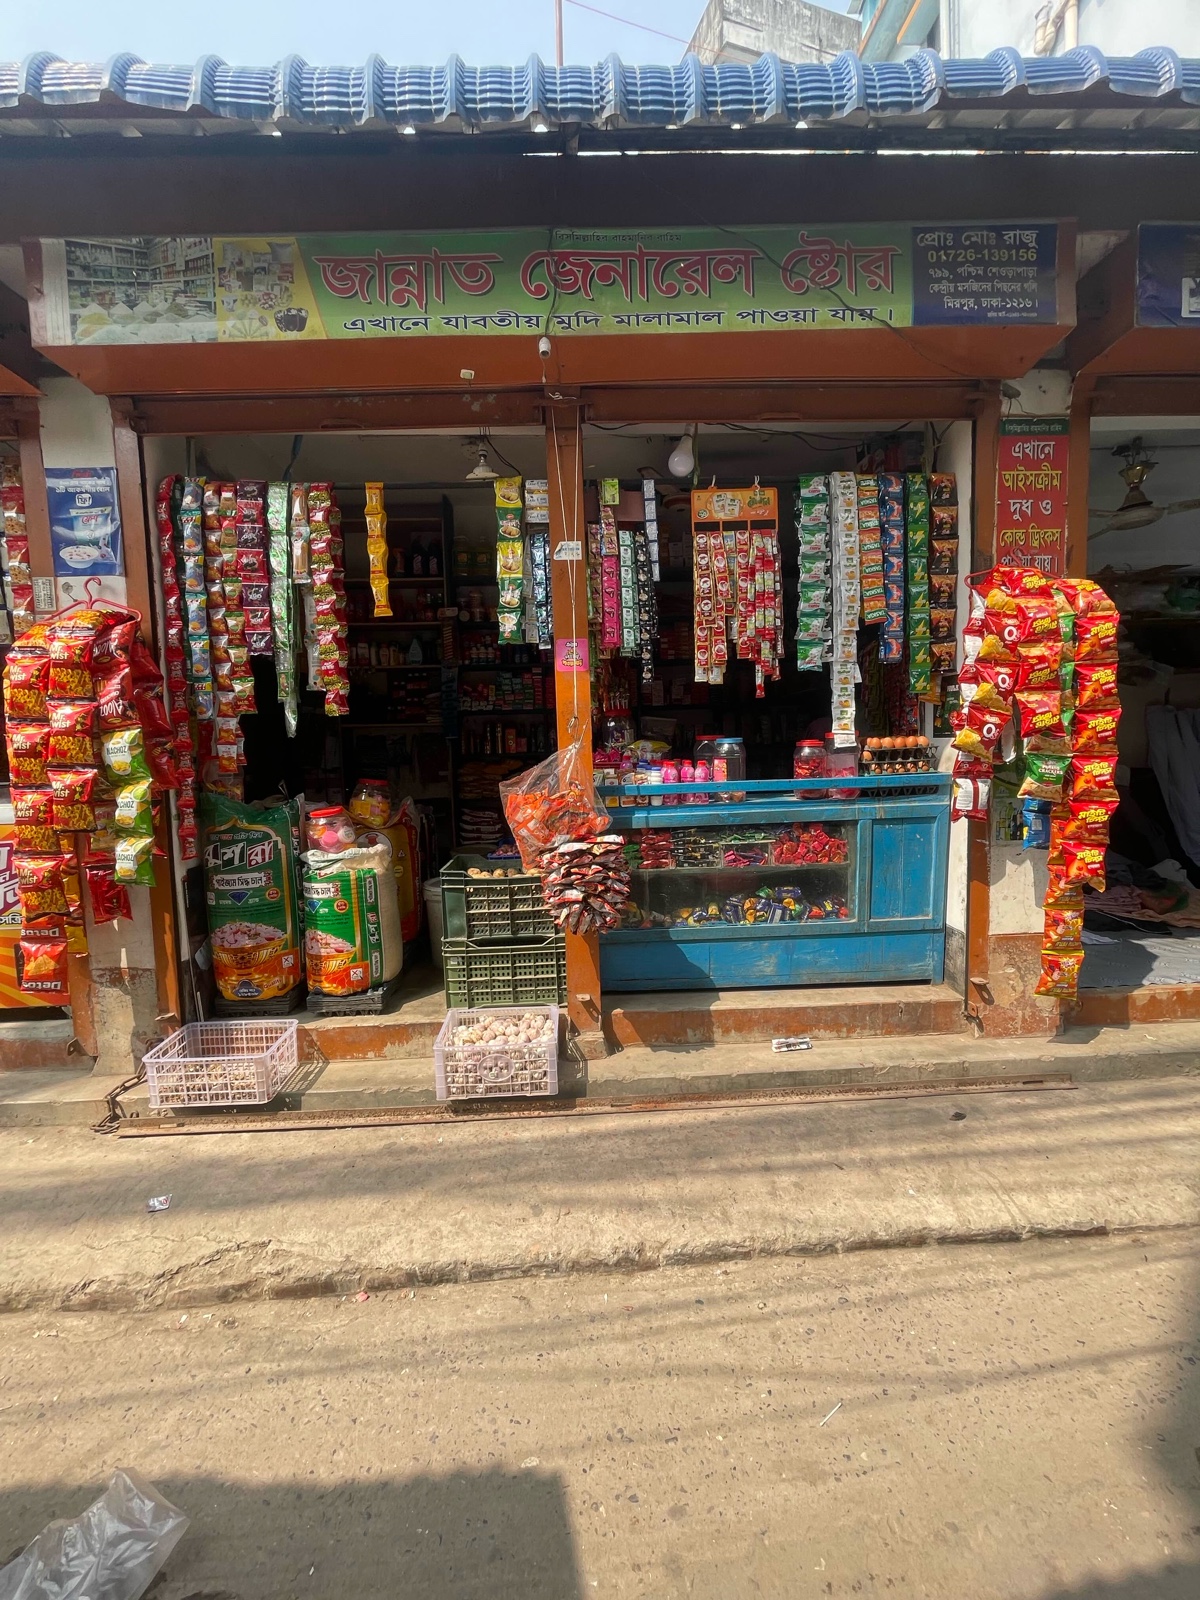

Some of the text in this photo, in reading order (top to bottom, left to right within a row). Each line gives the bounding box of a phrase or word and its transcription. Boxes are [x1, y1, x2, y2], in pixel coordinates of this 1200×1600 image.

[961, 229, 997, 246] মোঃ
[1002, 228, 1039, 249] রাজু
[927, 248, 1037, 262] 01726-139156
[312, 247, 505, 311] জান্নাত
[519, 242, 766, 302] জেনারেল
[928, 264, 1037, 280] ৭৯৯, পশ্চিম শেওড়াপাড়া
[943, 296, 978, 311] মিরপুর,
[343, 314, 431, 333] এখানে
[442, 310, 544, 332] যাবতীয়
[555, 310, 601, 332] মুদি
[615, 310, 726, 328] মালামাল
[735, 307, 820, 325] পাওয়া
[1012, 440, 1056, 460] এখানে
[1001, 462, 1062, 493] আইসক্রীম
[1009, 499, 1052, 522] দুধ ও
[106, 745, 128, 755] NACHOZ
